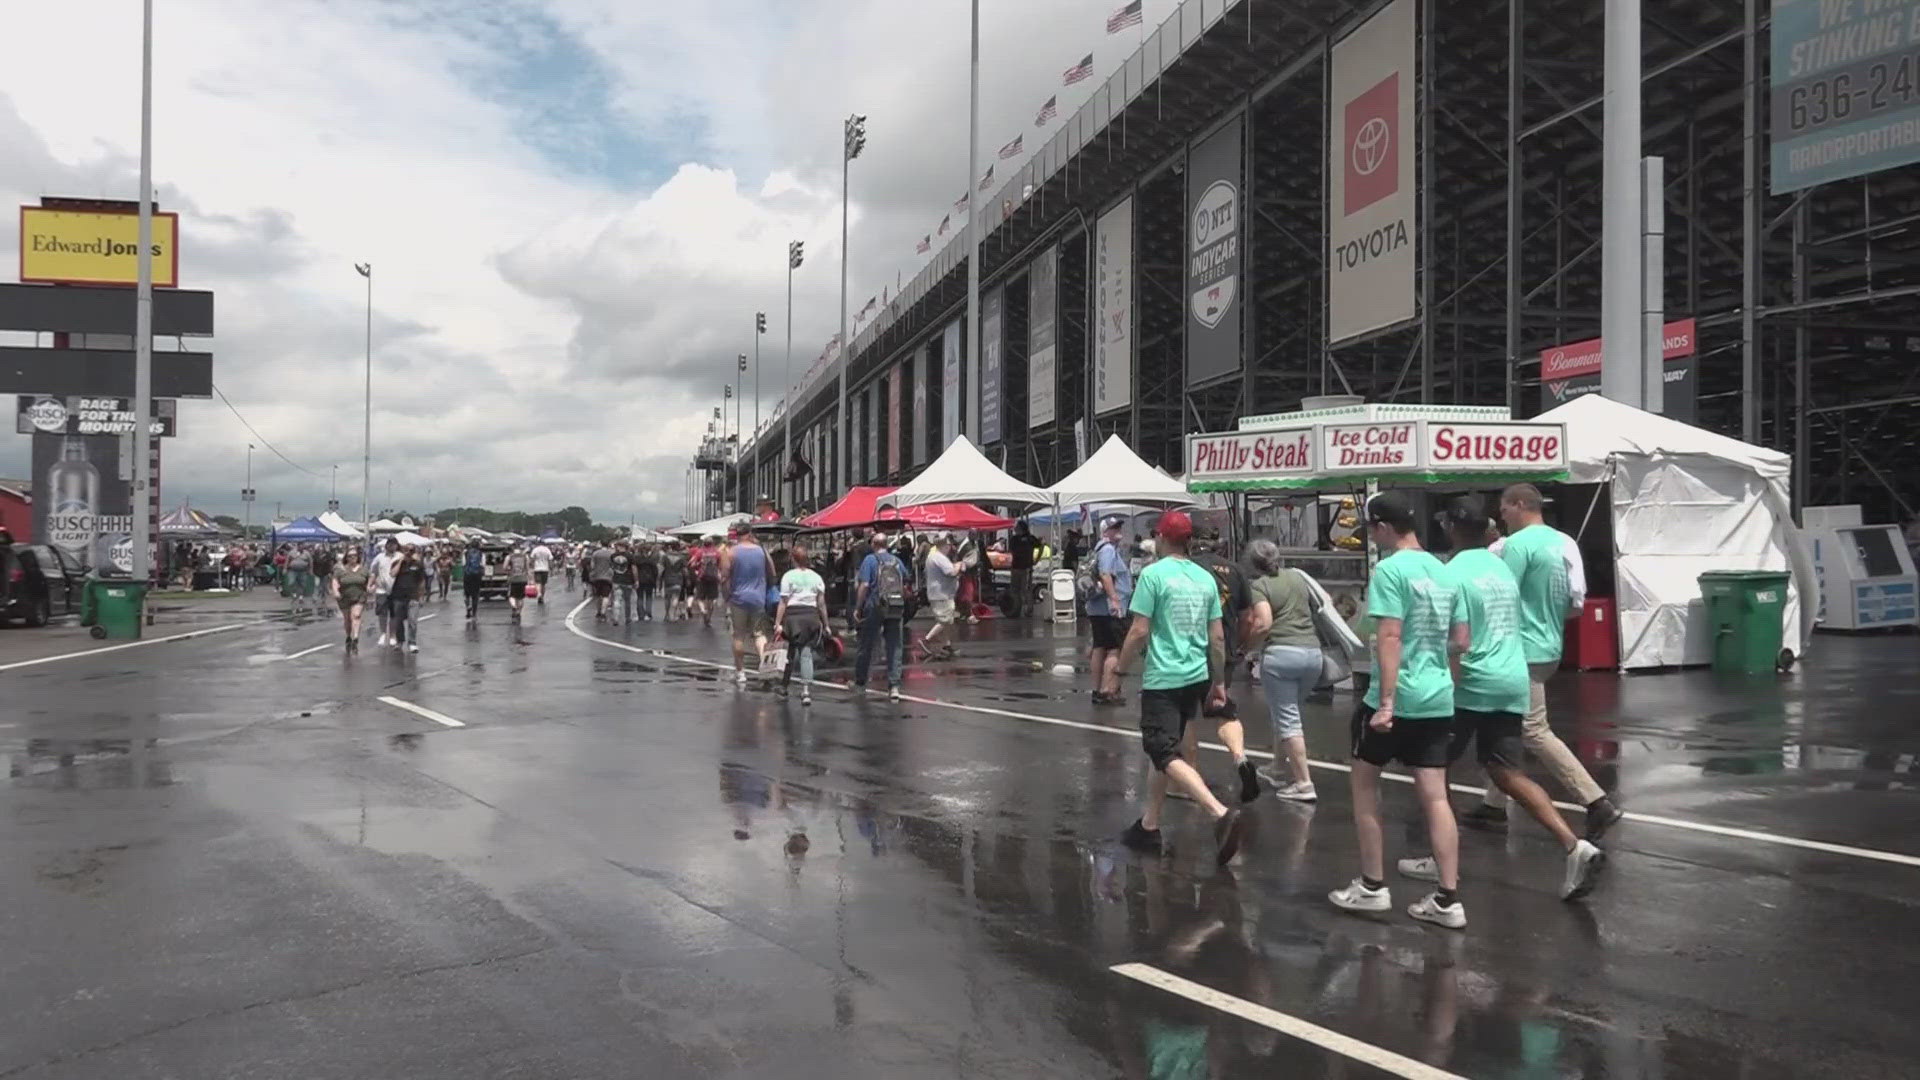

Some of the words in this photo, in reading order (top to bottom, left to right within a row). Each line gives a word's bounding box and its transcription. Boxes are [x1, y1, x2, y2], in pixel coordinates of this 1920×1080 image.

[1789, 11, 1904, 77] STINKING
[1790, 55, 1920, 130] 636-24
[1211, 200, 1233, 231] NTT
[33, 235, 102, 254] Edward
[104, 238, 162, 256] Jons
[1336, 219, 1408, 273] TOYOTA
[1191, 236, 1236, 278] INDYCAR
[1199, 263, 1226, 285] SERIES
[30, 408, 68, 419] BUSCH
[79, 399, 119, 410] RACE
[79, 411, 109, 421] FOR
[1331, 429, 1361, 446] Ice
[1364, 425, 1408, 445] Cold
[1433, 427, 1559, 462] Sausage
[1194, 440, 1248, 472] Philly
[1252, 434, 1309, 470] Steak
[1339, 447, 1404, 466] Drinks
[55, 533, 90, 541] LIGHT
